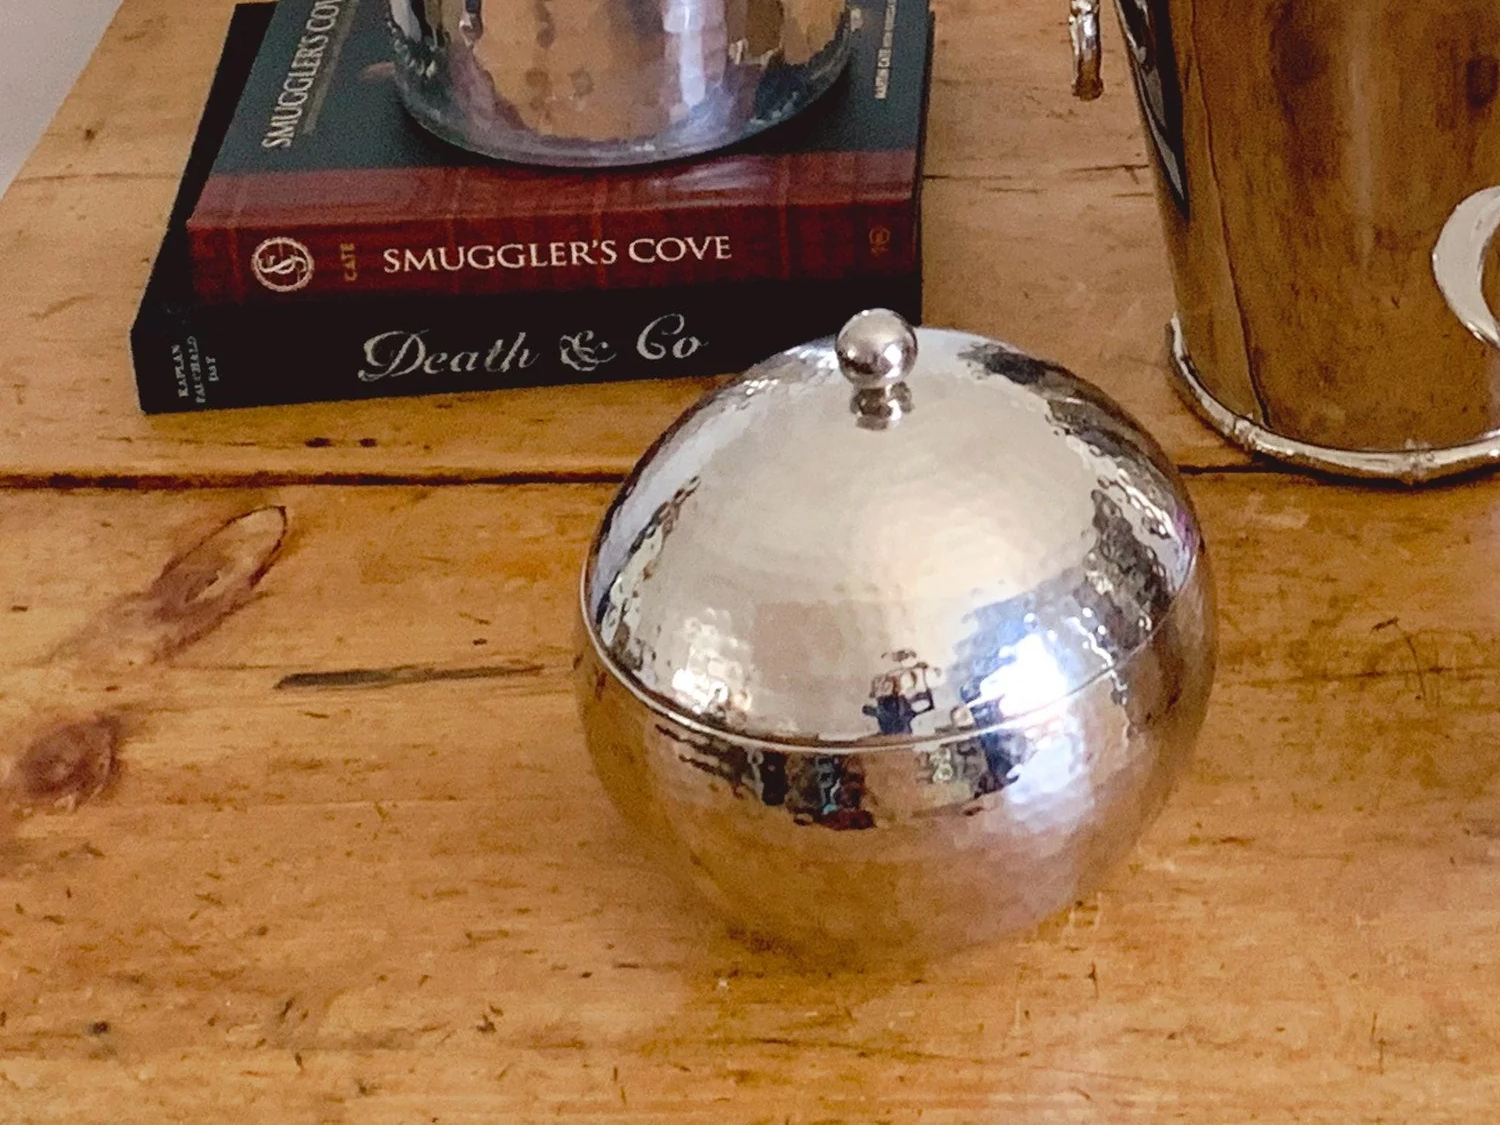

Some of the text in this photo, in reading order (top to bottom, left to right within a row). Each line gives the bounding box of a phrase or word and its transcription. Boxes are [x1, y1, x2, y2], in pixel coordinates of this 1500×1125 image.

[261, 36, 329, 148] SMUGGLER'S
[383, 235, 733, 274] SMUGGLER'S COVE
[357, 313, 709, 382] Death & Co
